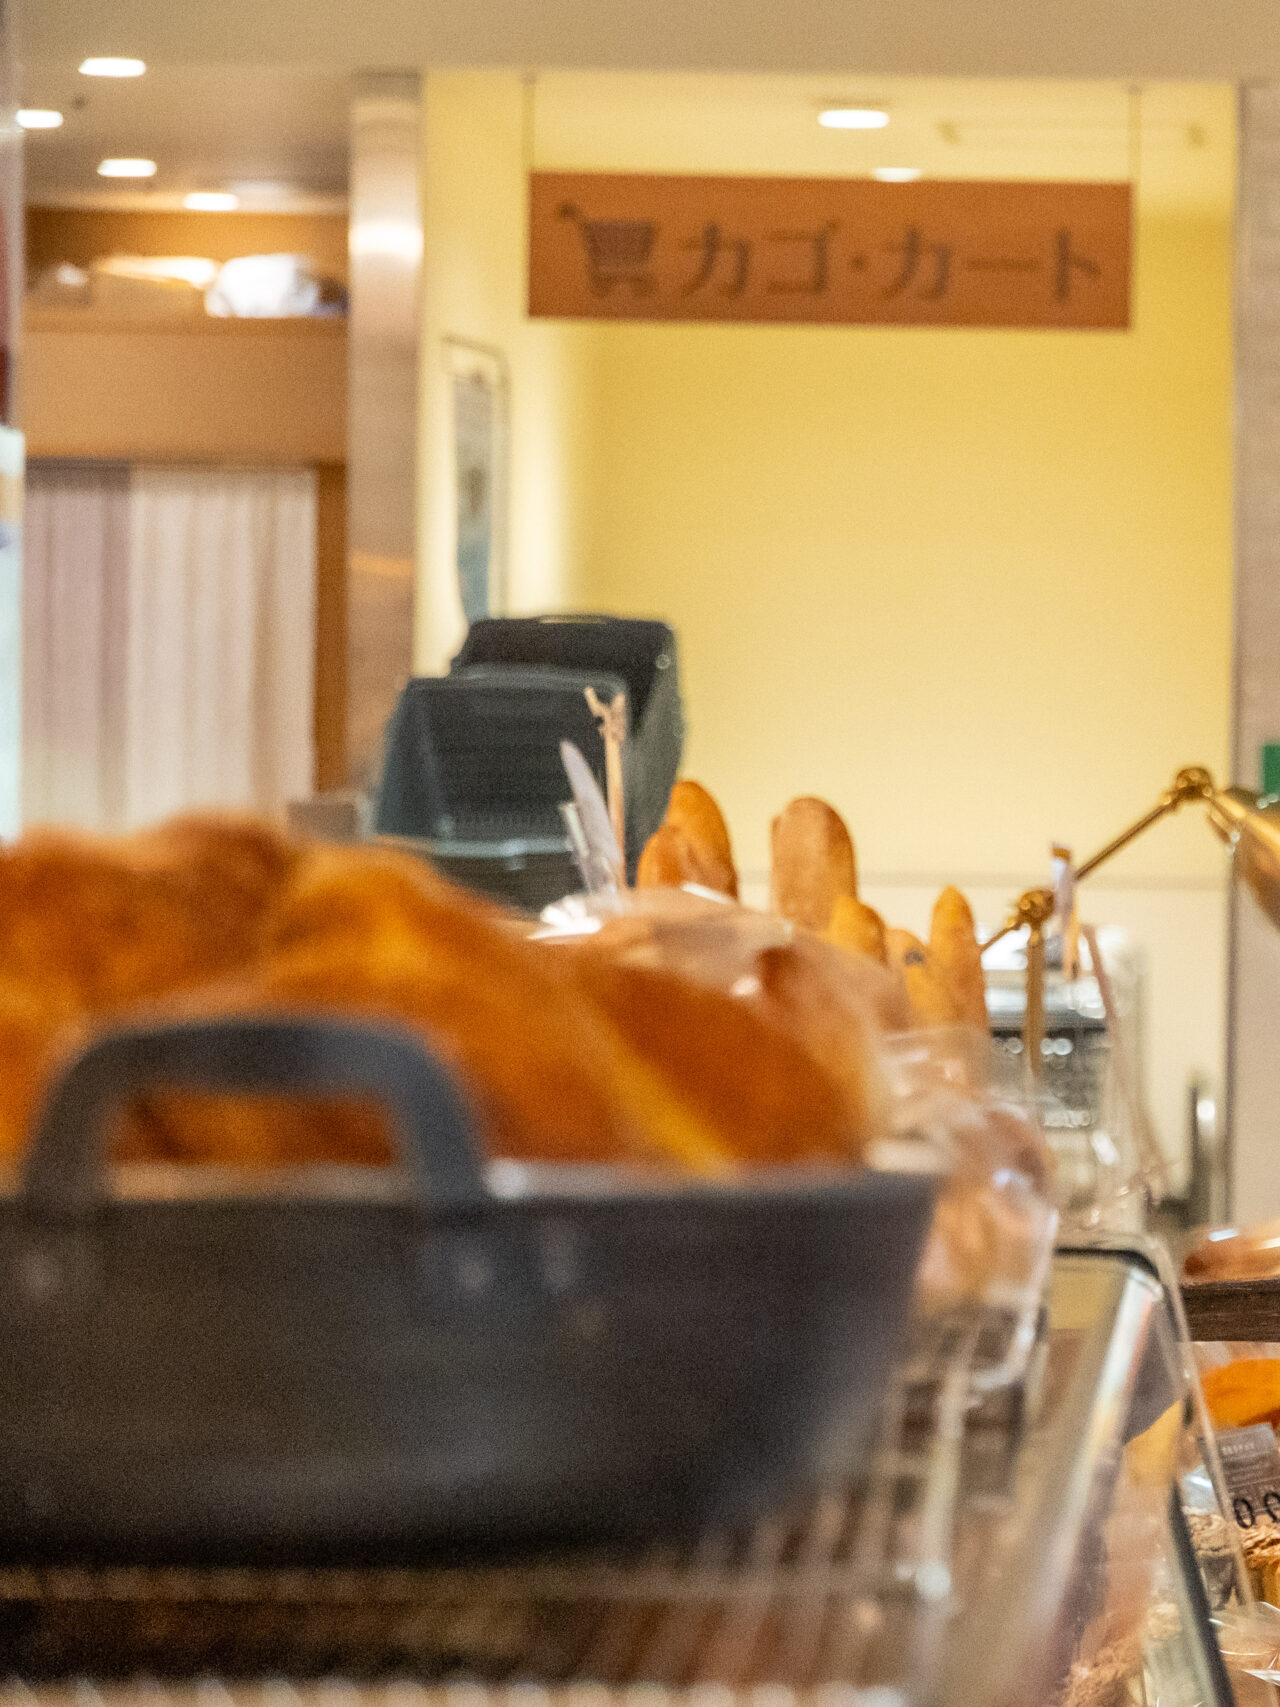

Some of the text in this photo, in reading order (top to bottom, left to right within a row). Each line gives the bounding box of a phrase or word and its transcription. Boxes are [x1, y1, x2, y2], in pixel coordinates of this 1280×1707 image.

[680, 221, 1101, 302] カゴ・カート
